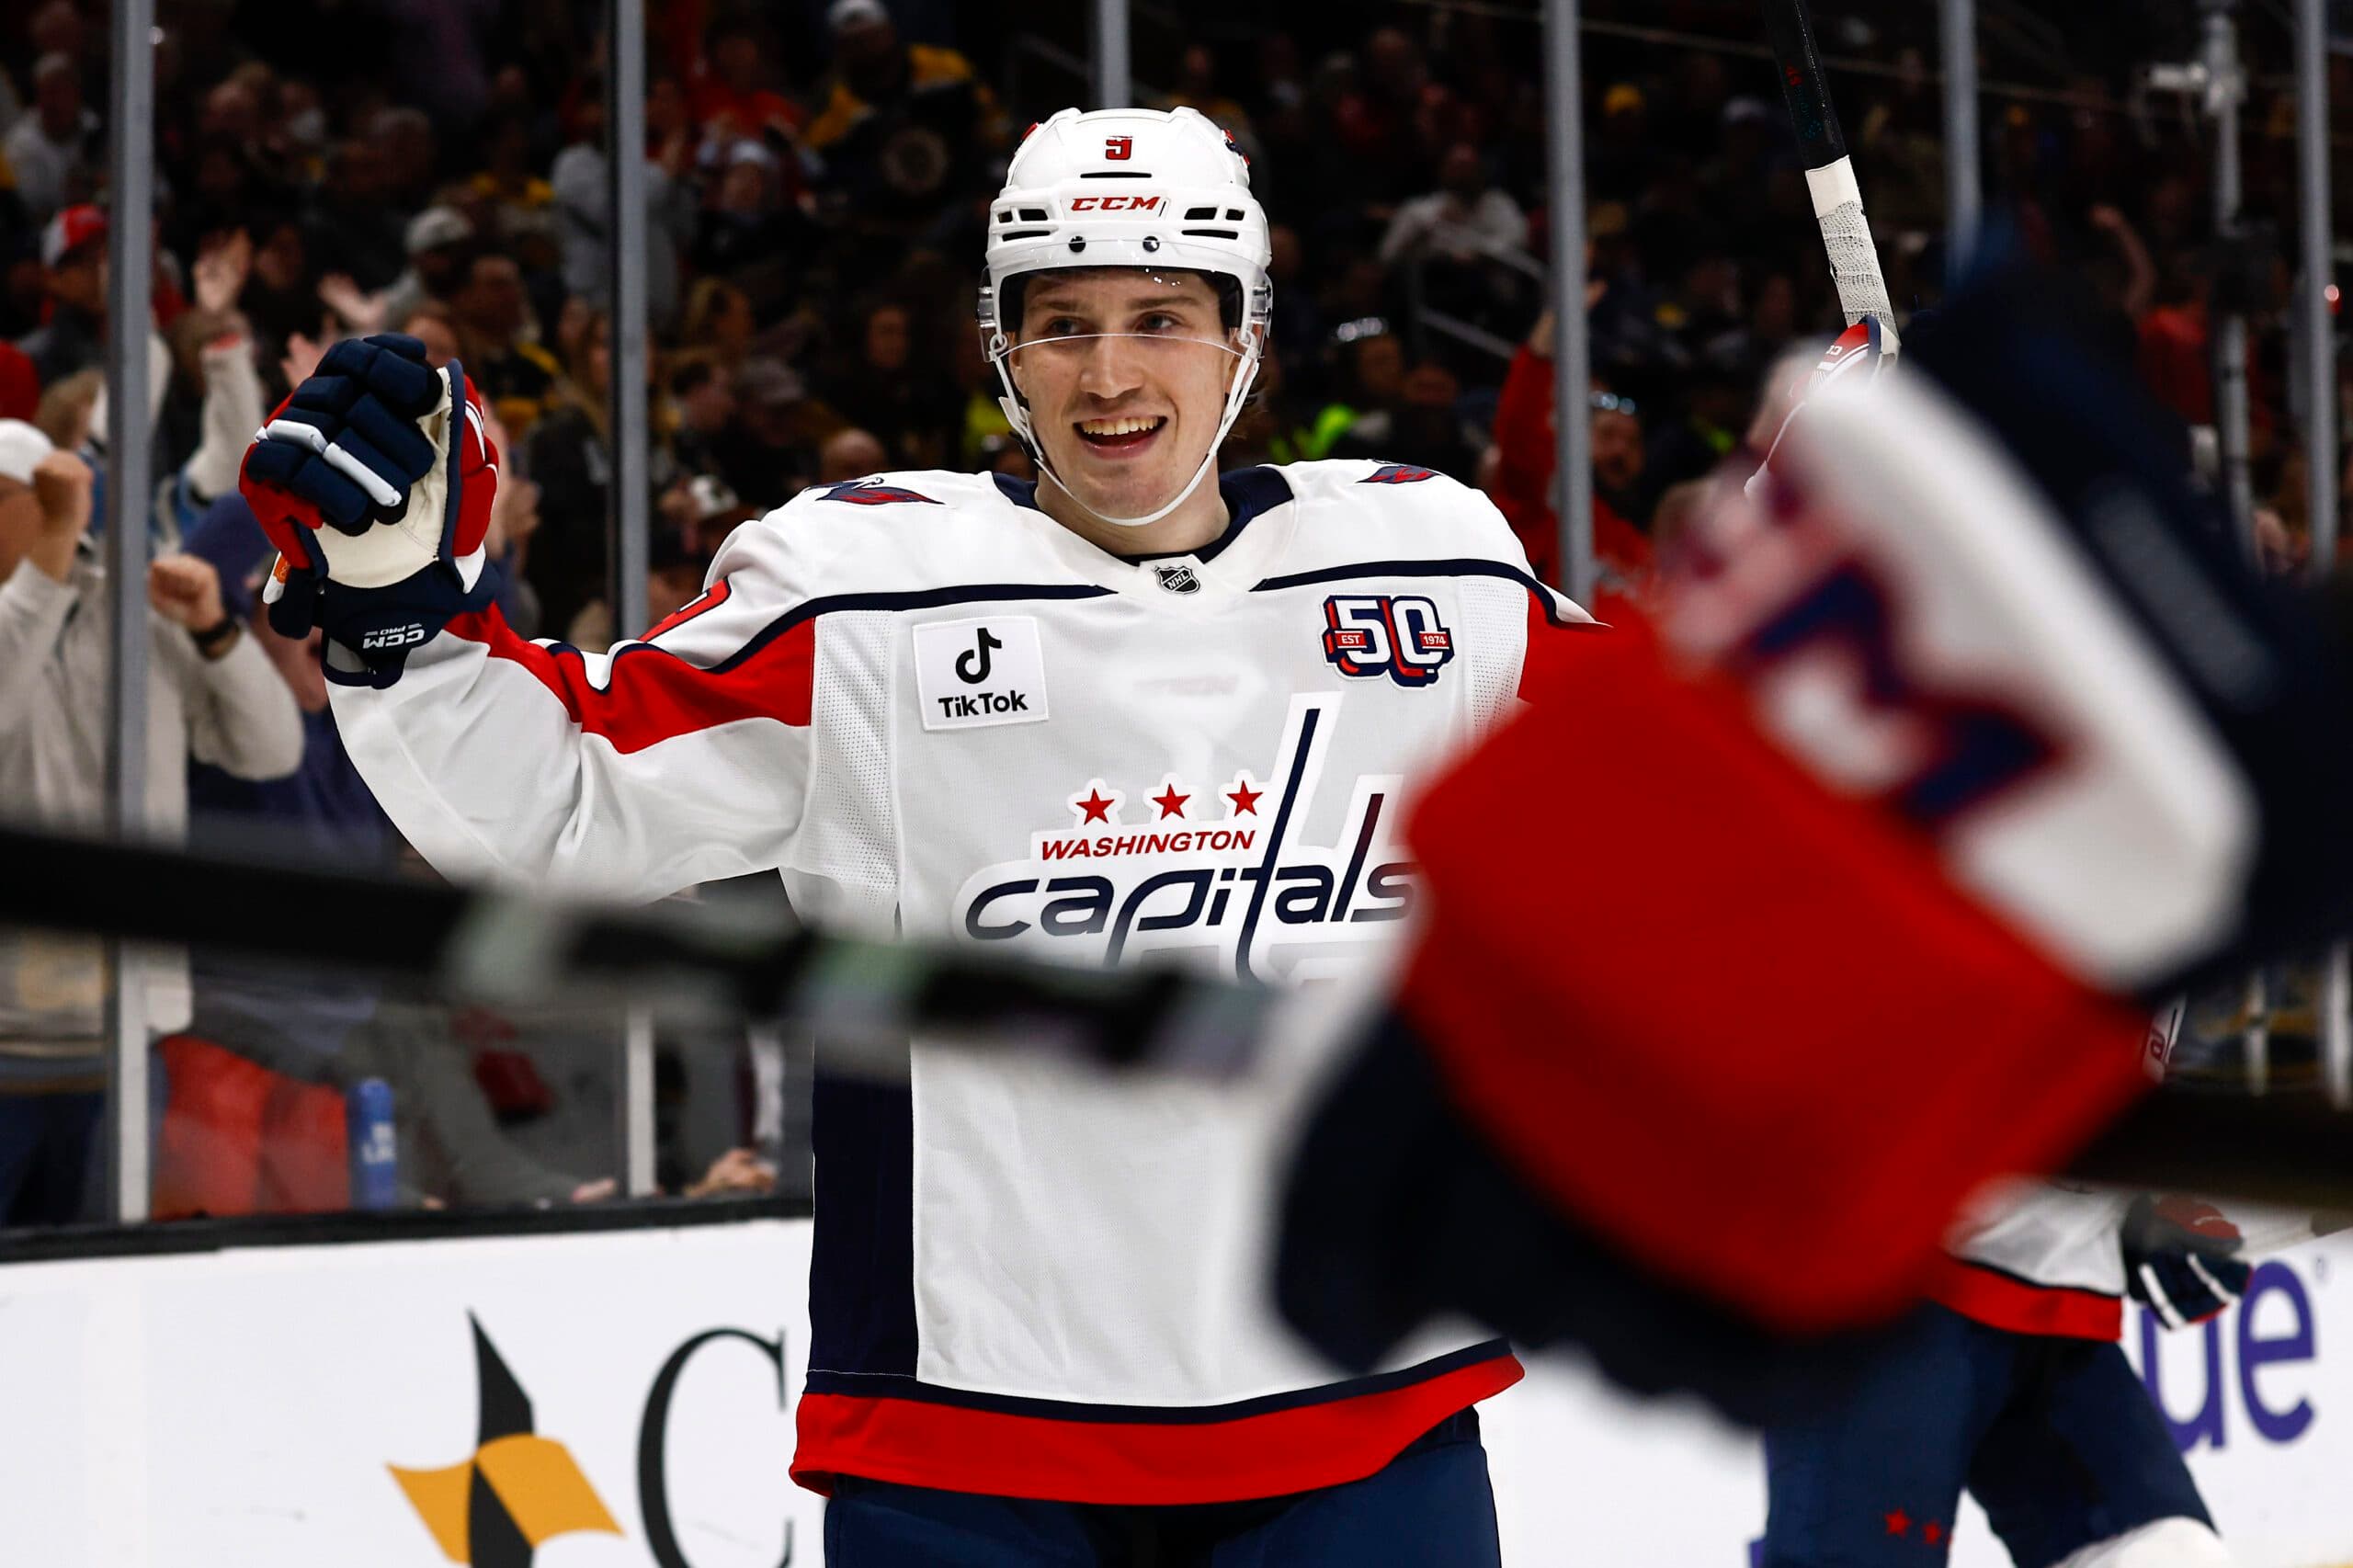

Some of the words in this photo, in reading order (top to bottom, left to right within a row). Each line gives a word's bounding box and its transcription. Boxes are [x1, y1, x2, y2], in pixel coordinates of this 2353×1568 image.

[1071, 196, 1161, 211] CCM
[1166, 573, 1189, 589] NHL
[362, 629, 425, 649] CCM
[1324, 596, 1446, 678] 50
[1341, 635, 1359, 644] EST
[1424, 635, 1447, 645] 1974
[938, 690, 1029, 718] TikTok
[1040, 830, 1256, 860] WASHINGTON
